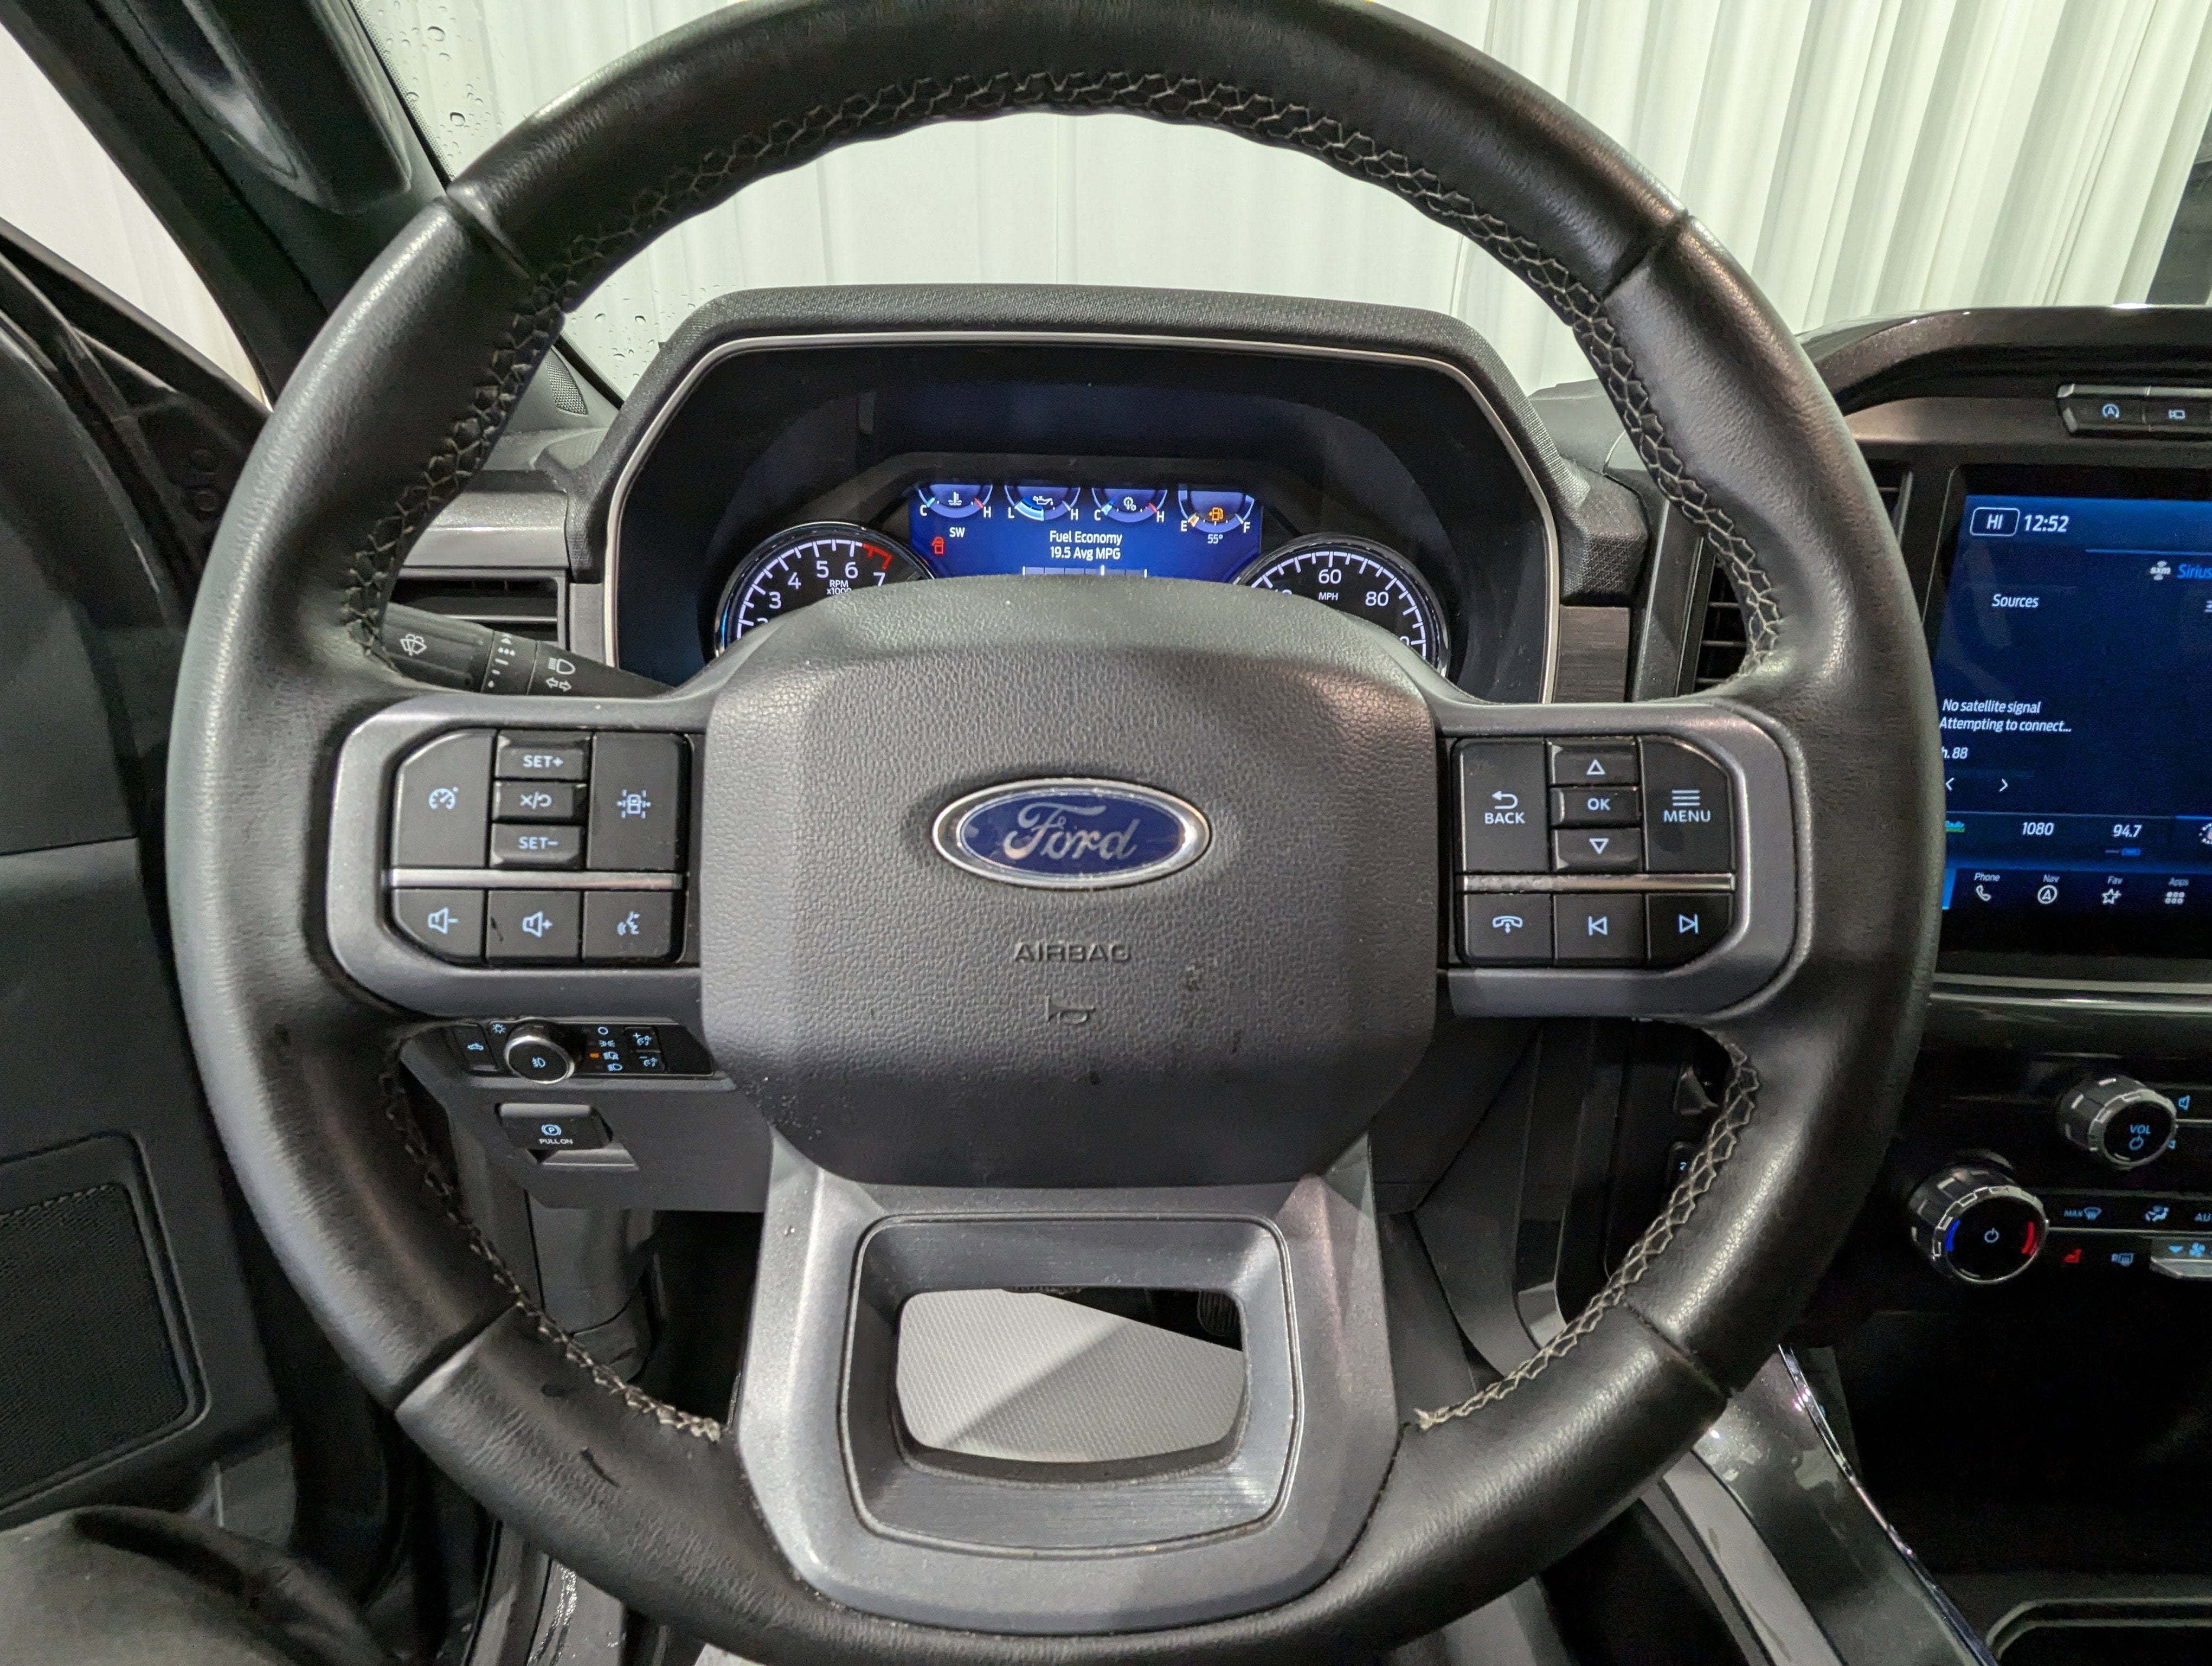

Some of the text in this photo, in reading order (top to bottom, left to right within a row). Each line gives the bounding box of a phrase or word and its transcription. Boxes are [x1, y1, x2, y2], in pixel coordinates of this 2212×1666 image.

[920, 504, 928, 516] C
[983, 506, 992, 518] H
[1008, 507, 1014, 518] L
[1070, 509, 1078, 521] H
[1094, 509, 1101, 521] C
[1156, 511, 1165, 523] H
[1986, 514, 2003, 530] HI
[1181, 520, 1187, 531] E
[1243, 522, 1251, 533] F
[2024, 515, 2069, 533] 12:52
[949, 527, 965, 537] SW
[1050, 530, 1122, 546] Fuel Economy
[1050, 546, 1121, 561] 19.5 Avg MPG
[816, 560, 829, 578] 5
[845, 561, 858, 579] 6
[788, 572, 801, 589] 4
[873, 572, 886, 586] 7
[1318, 569, 1342, 584] 60
[829, 579, 849, 588] RPM
[769, 592, 781, 609] 3
[1319, 592, 1339, 601] MPH
[1365, 591, 1389, 607] 80
[1991, 594, 2039, 608] Sources
[1942, 699, 2042, 715] No satellite signal
[1939, 716, 2004, 732] Attempting
[2006, 719, 2017, 731] to
[1952, 747, 1969, 759] 88
[523, 755, 563, 768] SET+
[1587, 798, 1610, 811] OK
[1484, 812, 1526, 825] BACK
[1663, 810, 1711, 823] MENU
[1003, 802, 1141, 860] Ford
[2022, 822, 2055, 836] 1080
[2113, 824, 2143, 838] 94.7
[1975, 872, 2001, 881] Phone
[2043, 874, 2060, 883] Nav
[1014, 941, 1132, 963] AIRBAG
[2130, 1124, 2151, 1135] VOL
